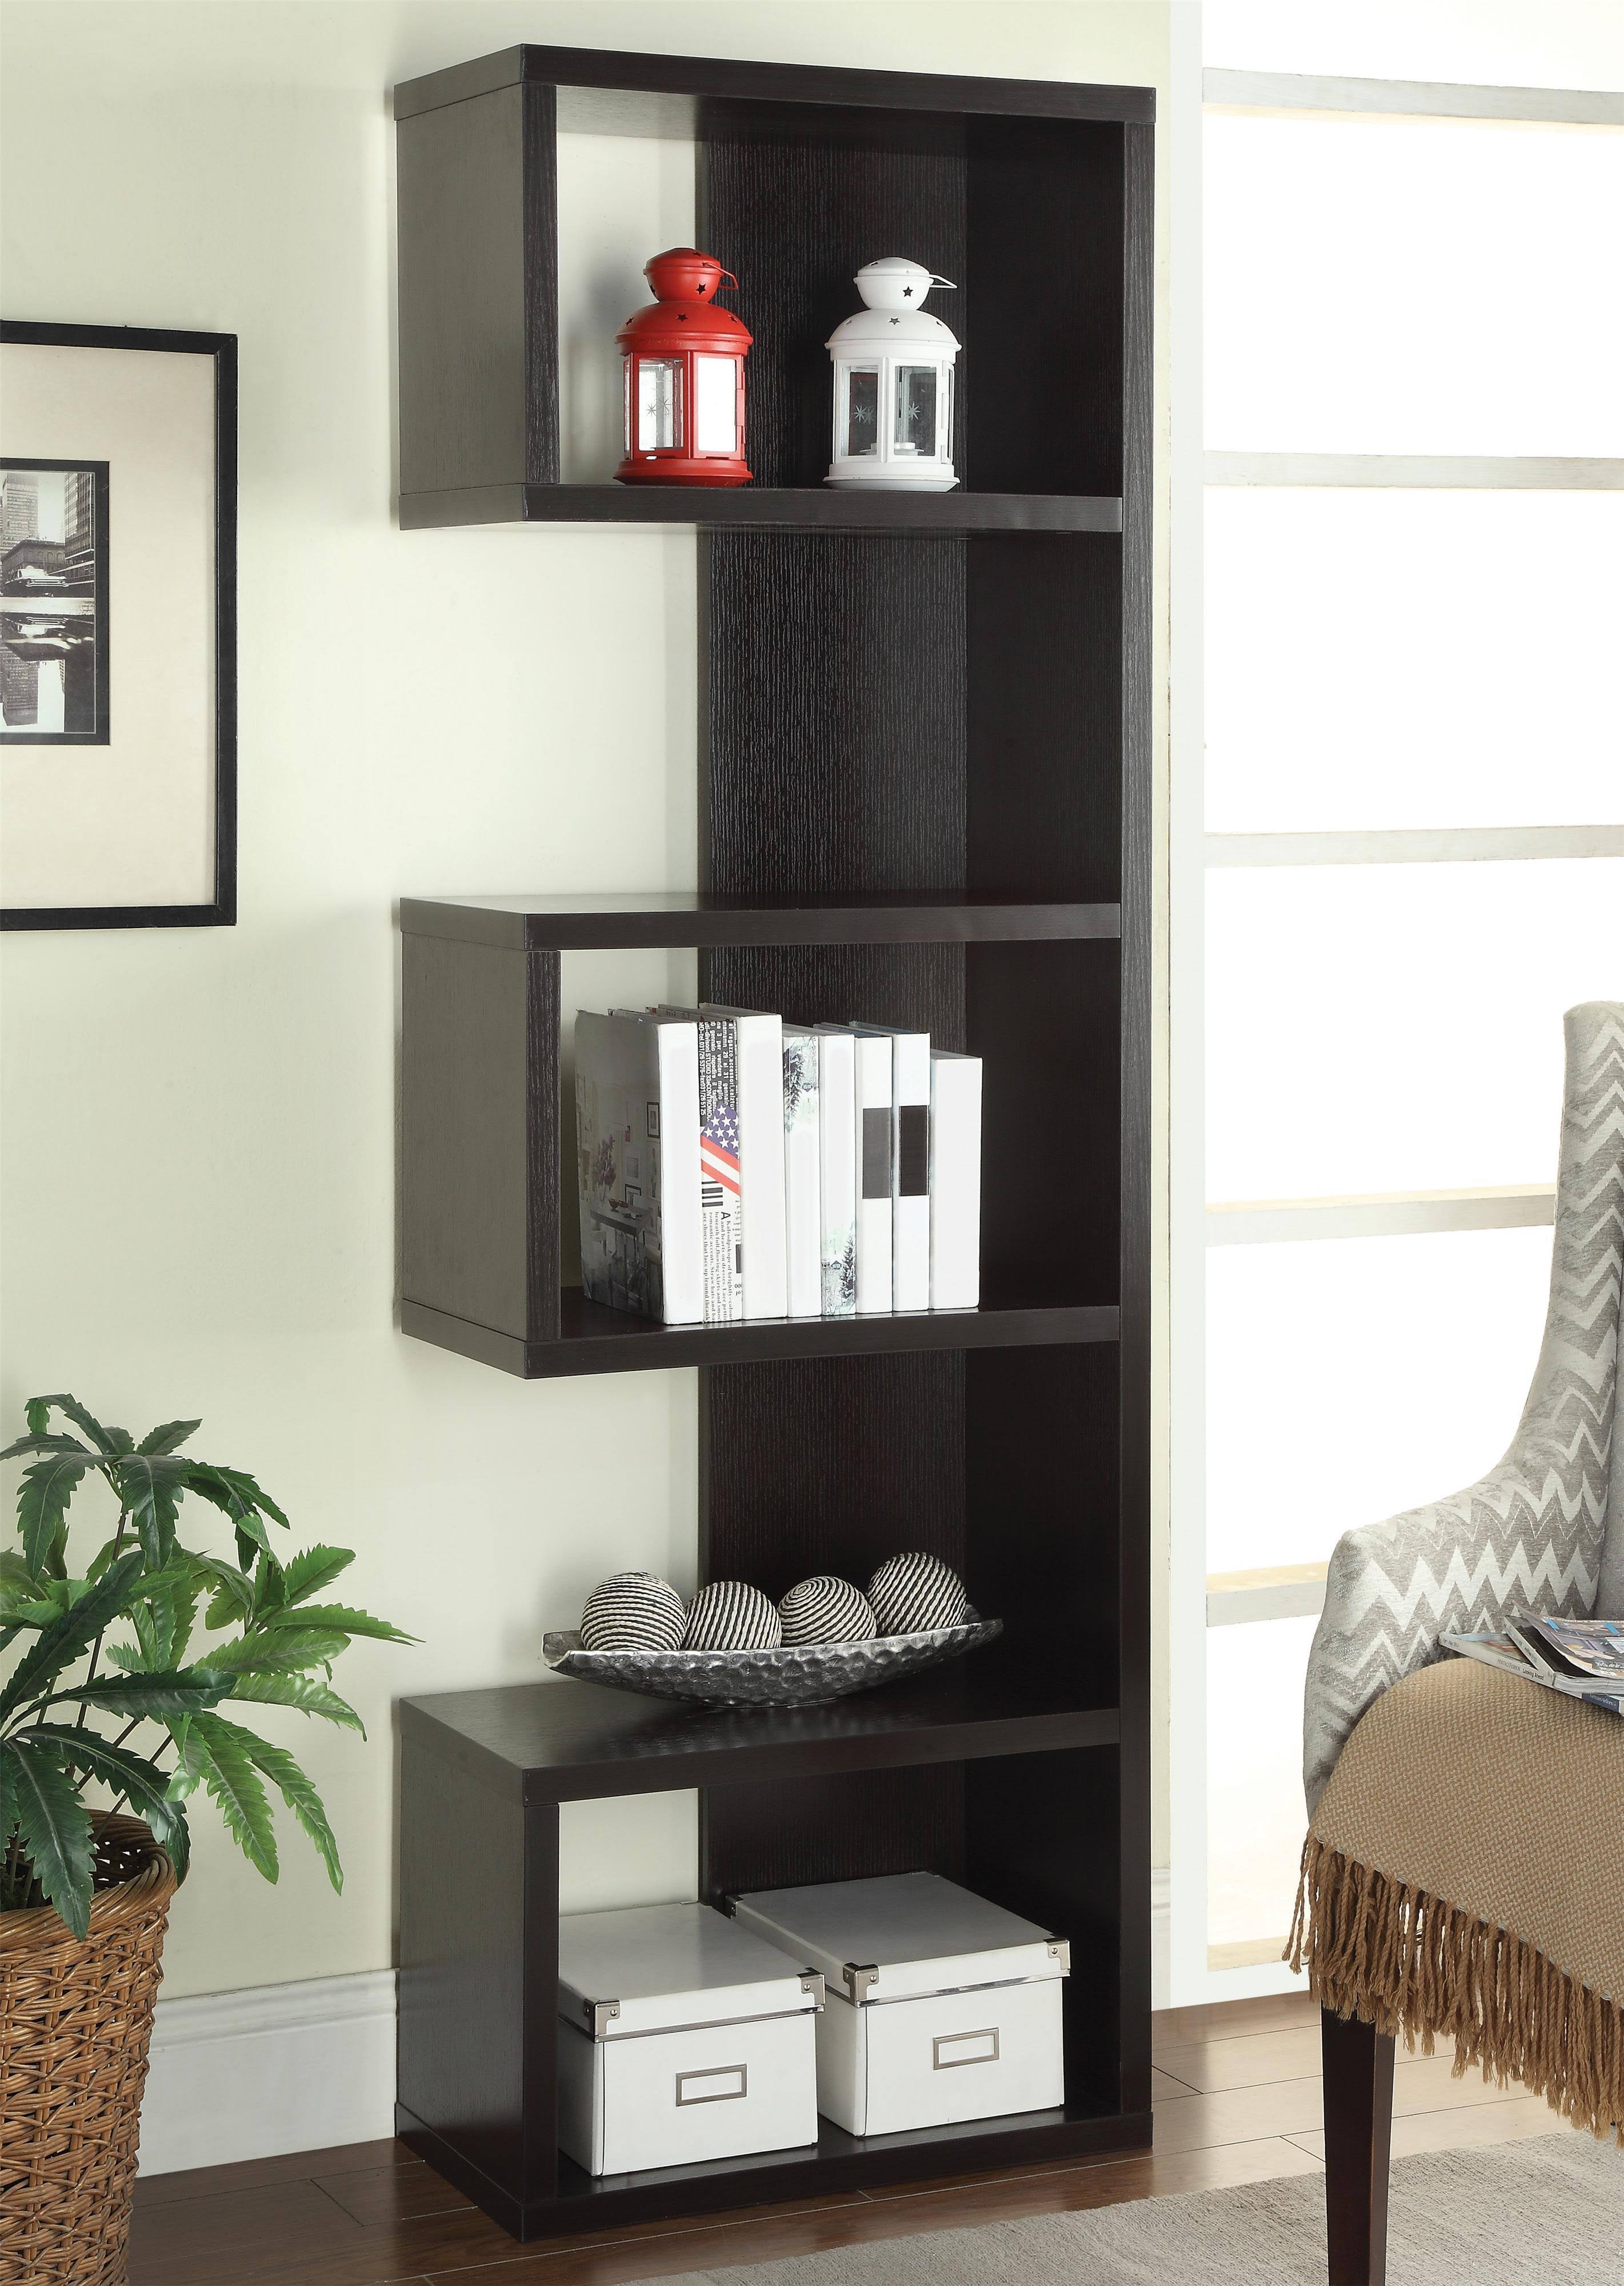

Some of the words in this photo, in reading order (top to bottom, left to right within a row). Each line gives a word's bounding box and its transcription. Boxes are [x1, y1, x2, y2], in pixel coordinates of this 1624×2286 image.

[721, 1212, 731, 1220] A
[722, 1254, 725, 1262] on
[1522, 1668, 1534, 1678] Looking
